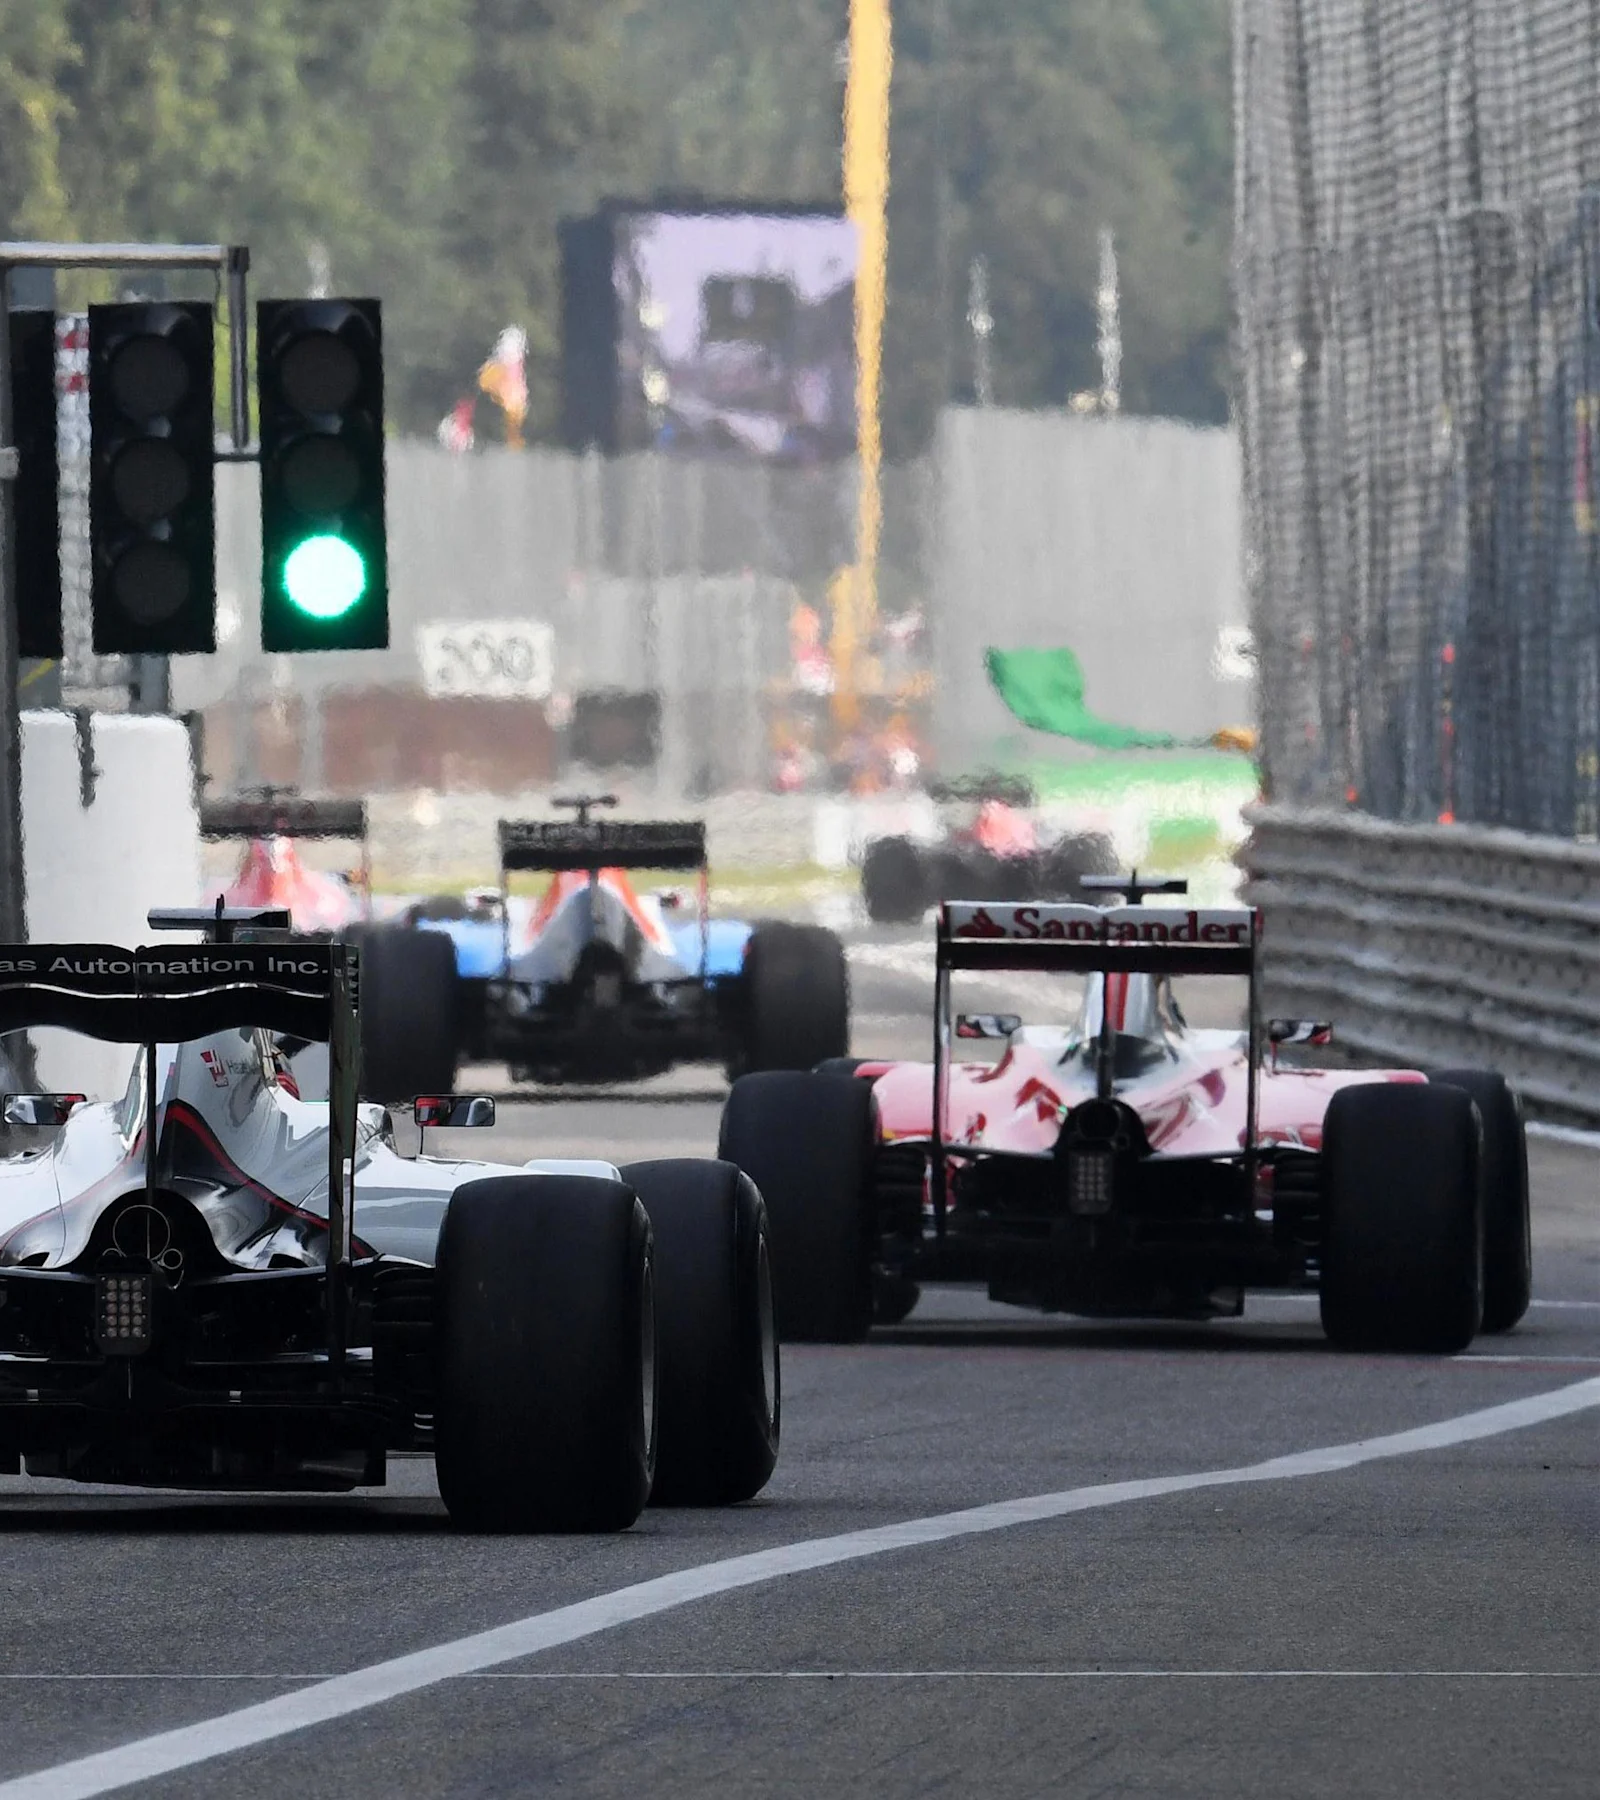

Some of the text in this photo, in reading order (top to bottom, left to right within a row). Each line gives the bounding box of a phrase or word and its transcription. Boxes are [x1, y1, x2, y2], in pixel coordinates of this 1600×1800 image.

[1013, 907, 1248, 942] Santander
[48, 957, 254, 974] Automation
[268, 957, 329, 974] Inc.
